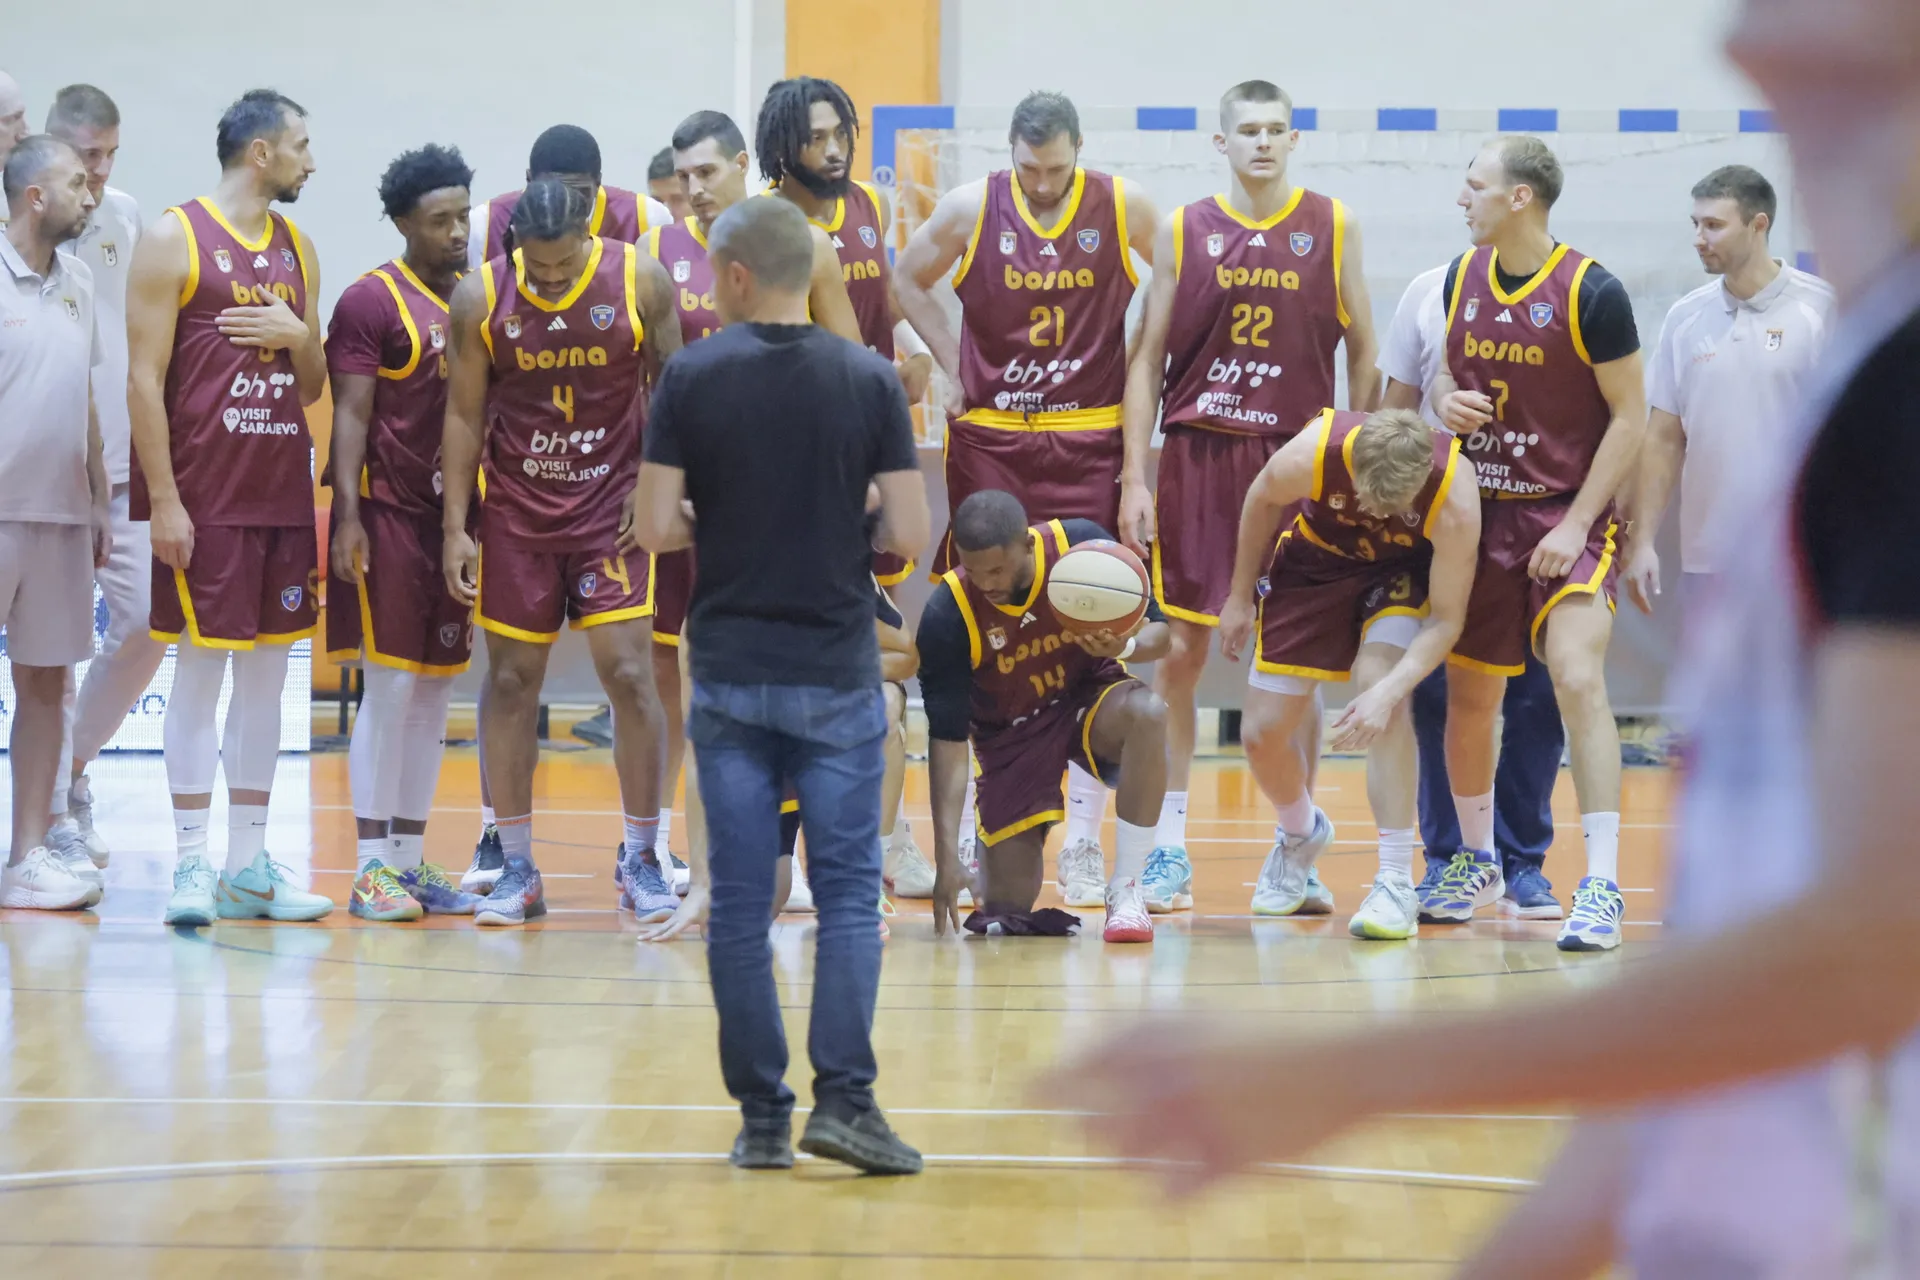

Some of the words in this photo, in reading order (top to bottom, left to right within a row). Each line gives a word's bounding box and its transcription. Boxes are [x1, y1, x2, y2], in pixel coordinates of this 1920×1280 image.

[1004, 265, 1094, 290] bosna
[1215, 263, 1300, 290] bosna
[1029, 306, 1064, 347] 21
[1230, 303, 1273, 348] 22
[515, 346, 607, 371] bosna
[1464, 331, 1544, 365] bosna
[552, 384, 575, 424] 4
[1011, 391, 1044, 404] VISIT
[1212, 391, 1243, 406] VISIT
[1490, 379, 1509, 421] 7
[225, 411, 239, 421] SA
[241, 407, 271, 420] VISIT
[1206, 403, 1278, 426] SARAJEVO
[239, 421, 298, 435] SARAJEVO
[538, 459, 572, 472] VISIT
[540, 463, 610, 482] SARAJEVO
[1476, 461, 1511, 477] VISIT
[602, 555, 632, 595] 4
[1389, 573, 1411, 600] 3
[1029, 664, 1065, 697] 14
